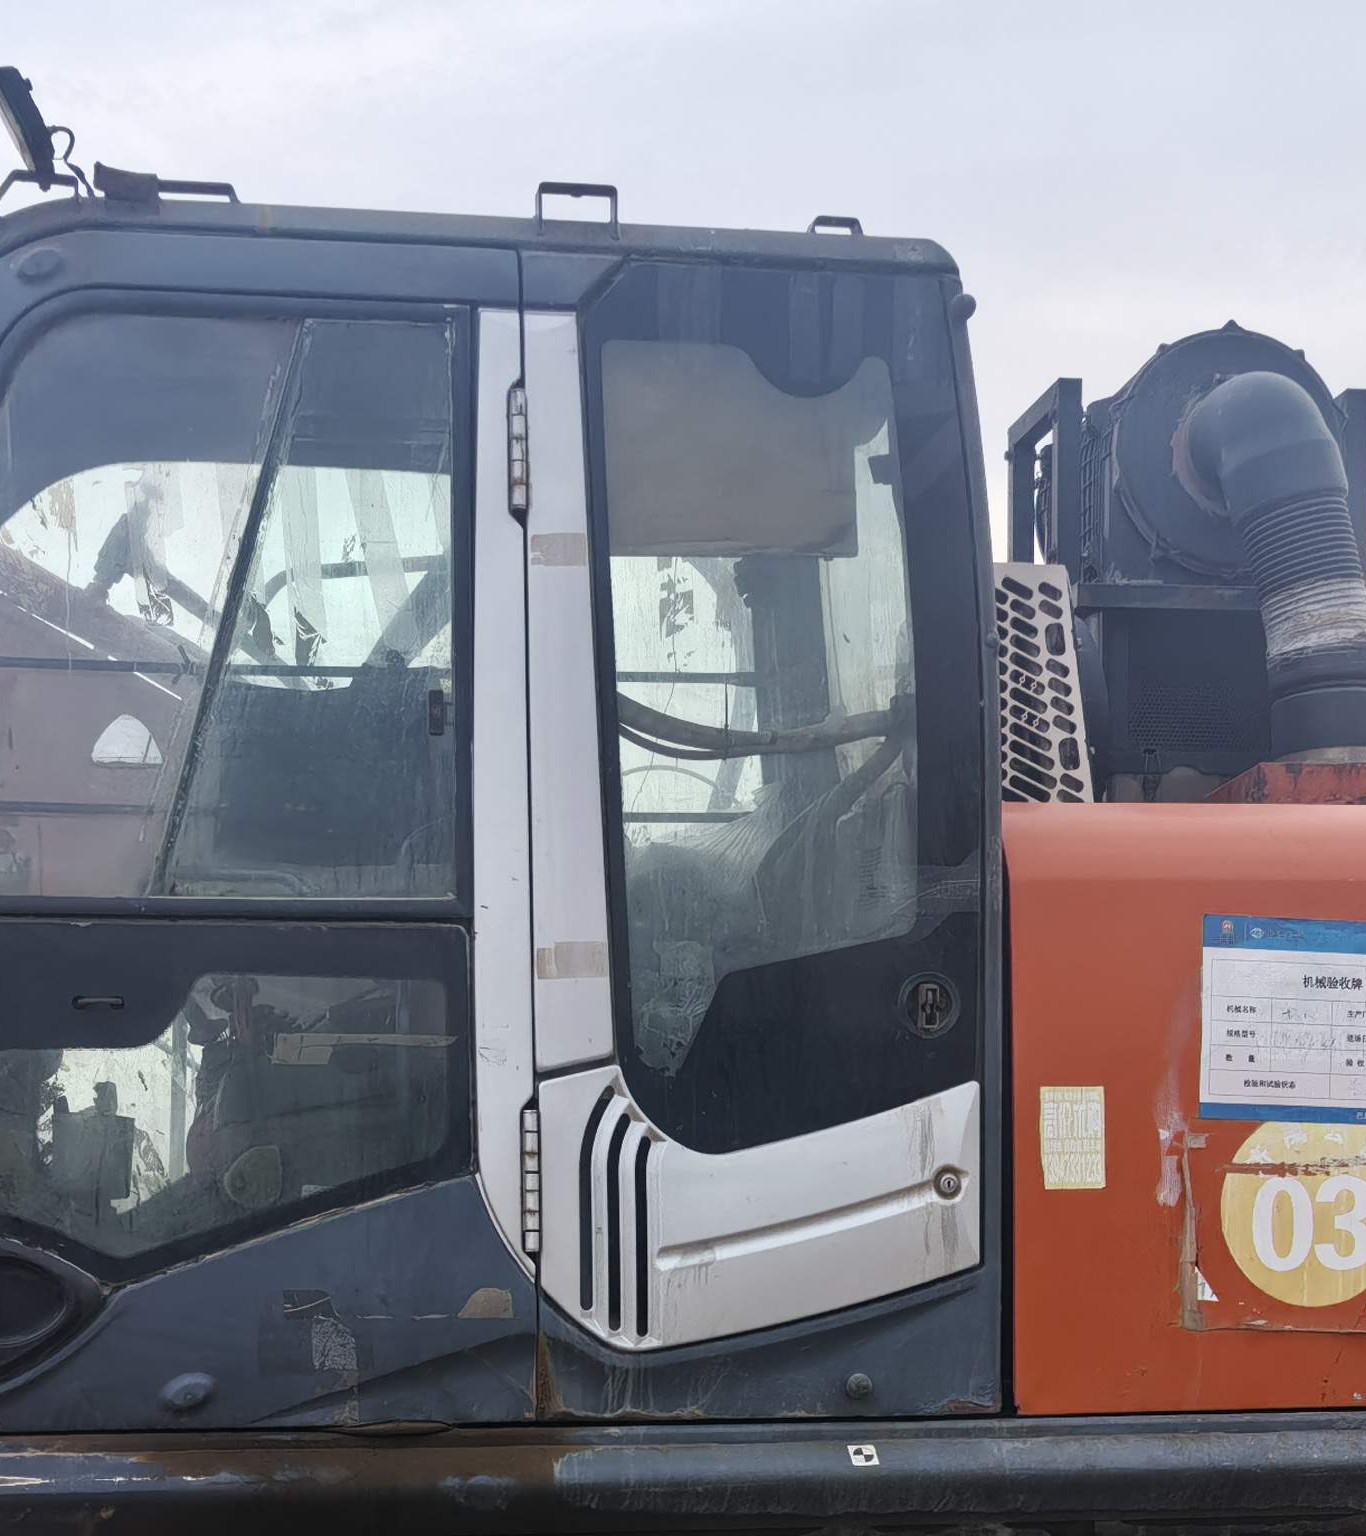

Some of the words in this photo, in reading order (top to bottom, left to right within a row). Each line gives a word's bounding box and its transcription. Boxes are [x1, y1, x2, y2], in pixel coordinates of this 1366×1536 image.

[1302, 975, 1364, 991] 机械验收牌
[1226, 1004, 1257, 1014] 机械名称
[1226, 1028, 1257, 1038] 规格型号
